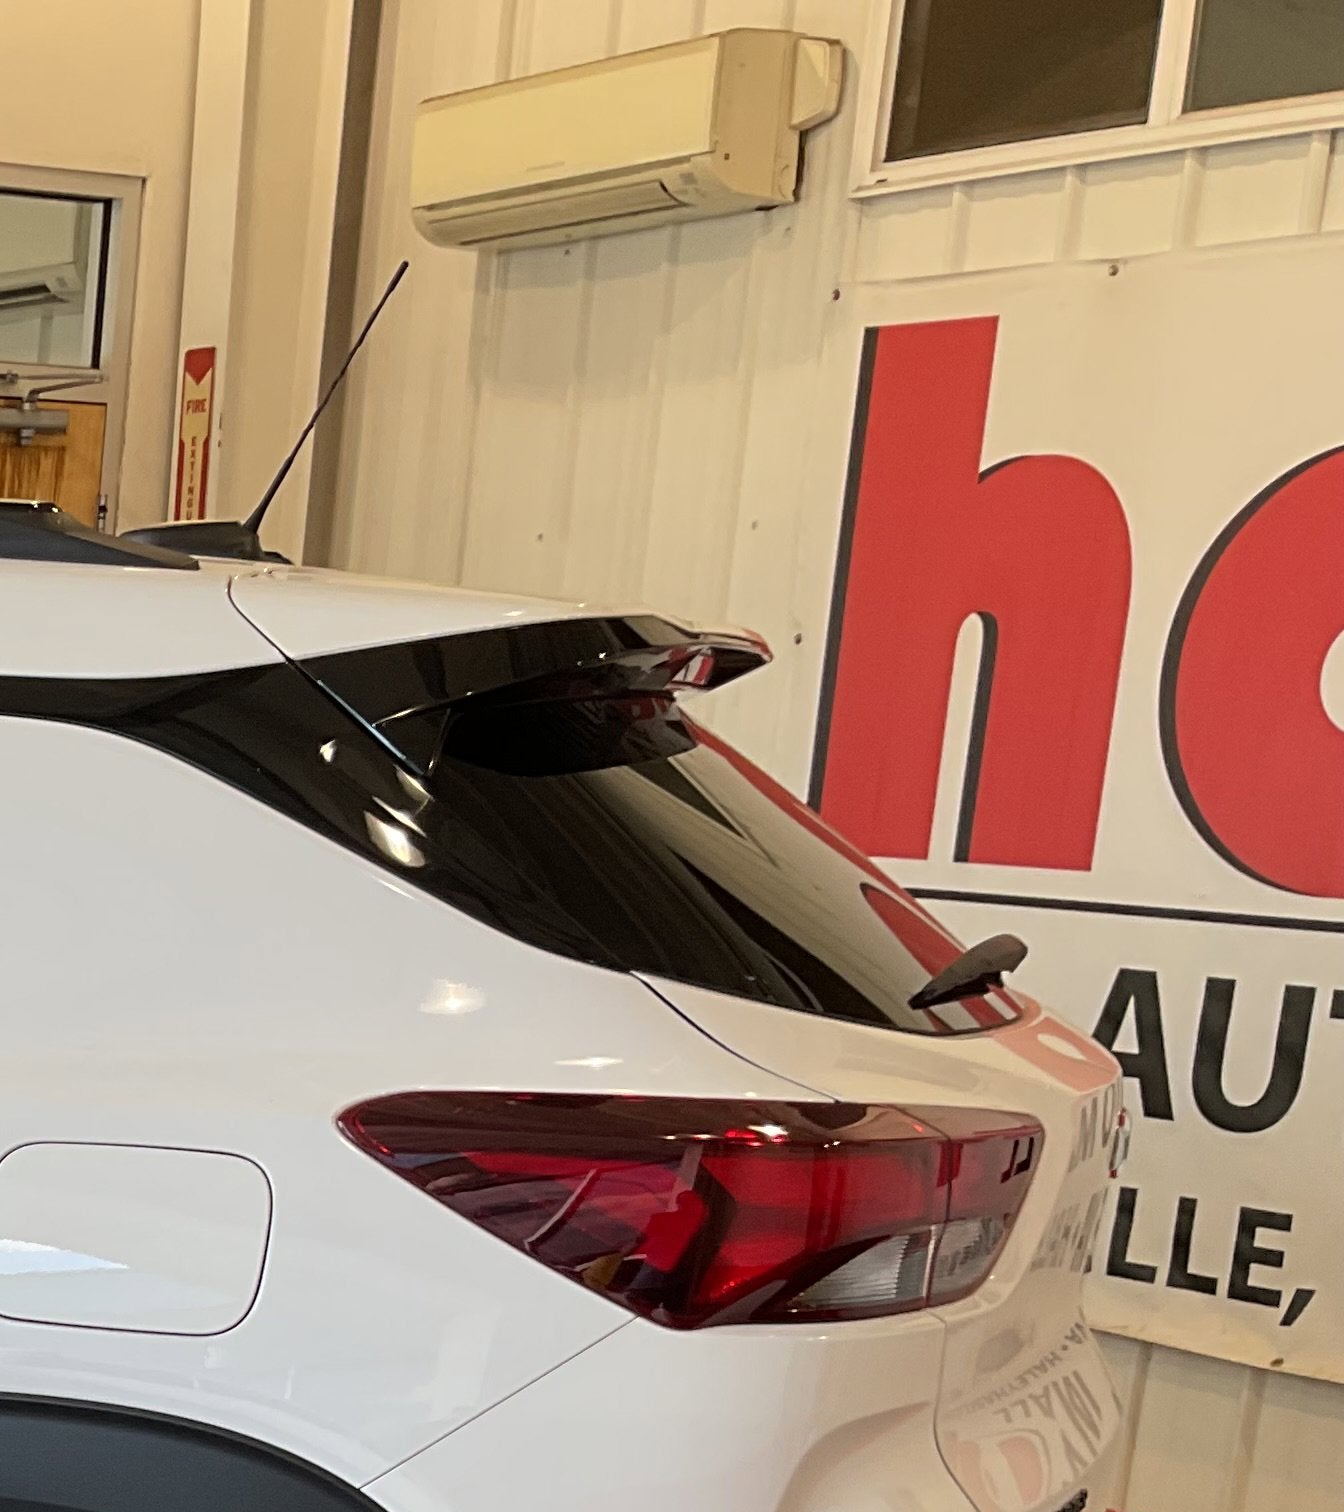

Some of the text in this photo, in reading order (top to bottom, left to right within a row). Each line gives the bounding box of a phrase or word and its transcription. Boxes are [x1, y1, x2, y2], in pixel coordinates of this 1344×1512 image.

[185, 398, 207, 415] FIRE
[1090, 967, 1344, 1134] AU
[1083, 1186, 1317, 1327] LLE,
